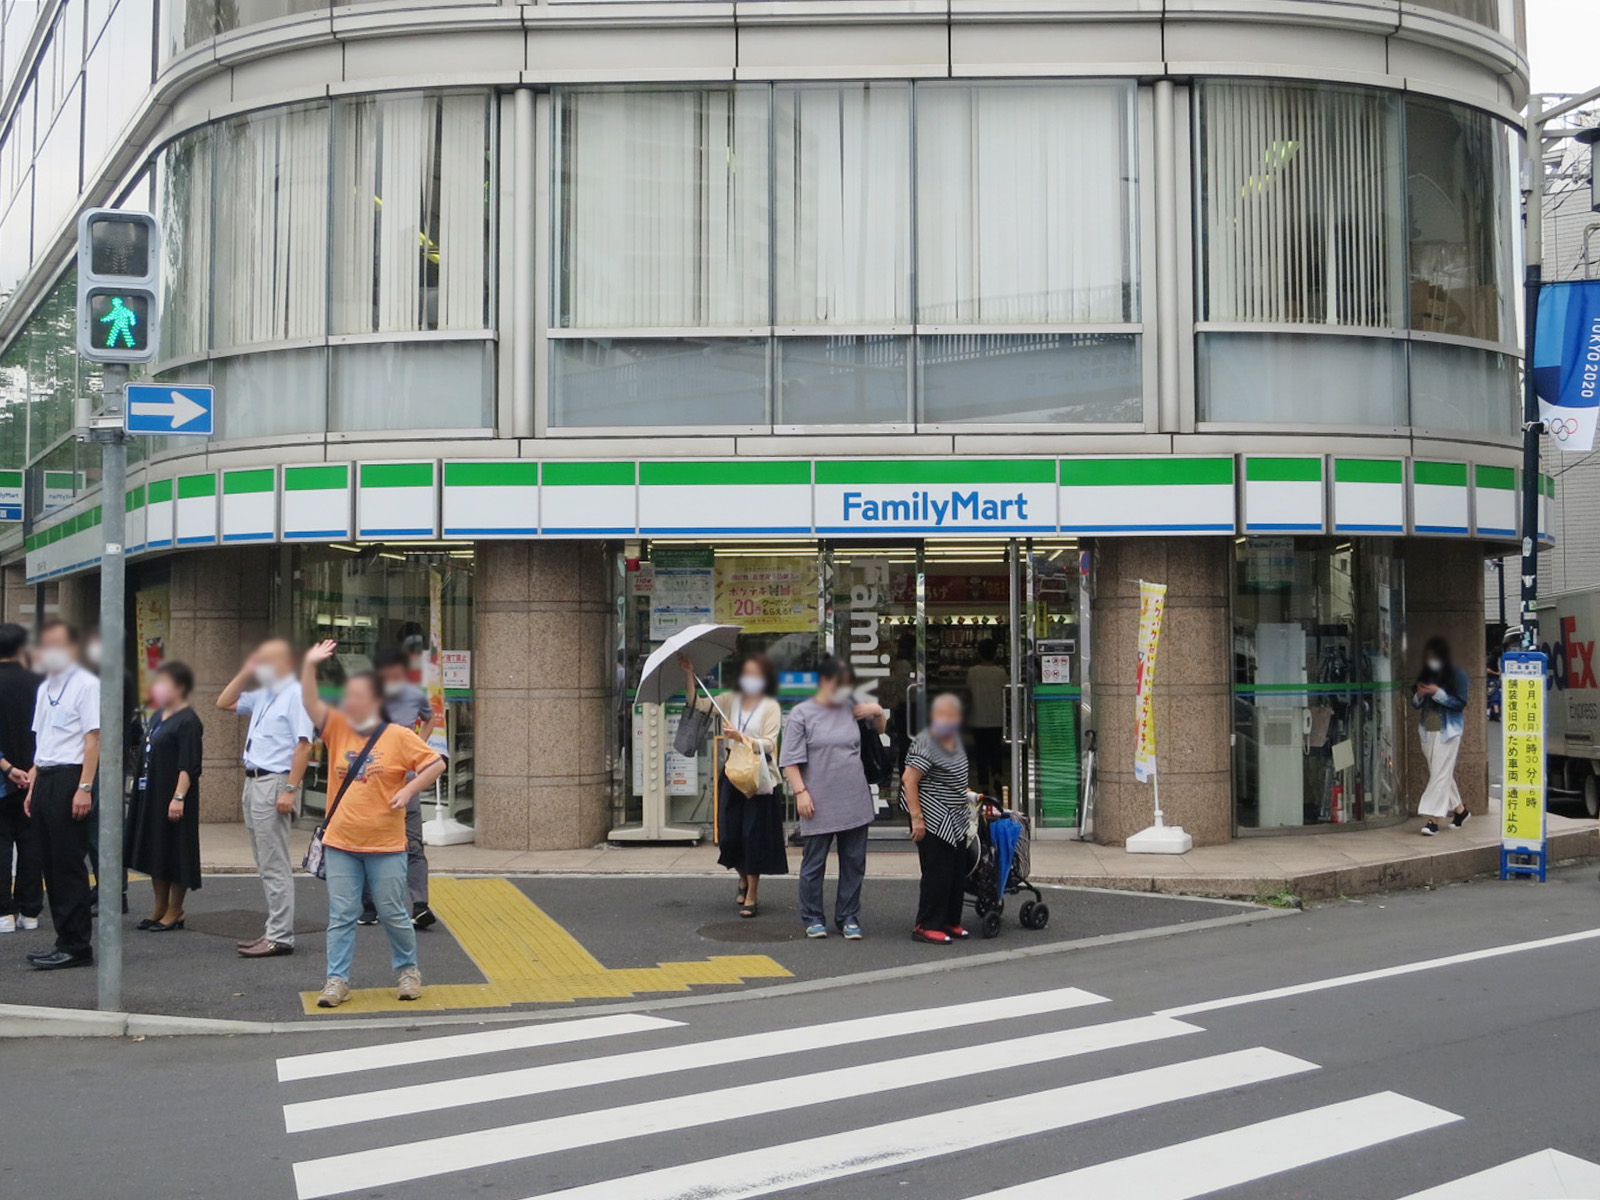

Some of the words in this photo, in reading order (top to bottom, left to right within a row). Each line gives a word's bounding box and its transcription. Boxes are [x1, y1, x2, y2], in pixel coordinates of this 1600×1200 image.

[1581, 363, 1598, 398] 2020
[842, 491, 1029, 525] FamilyMart
[1541, 616, 1598, 691] edEx
